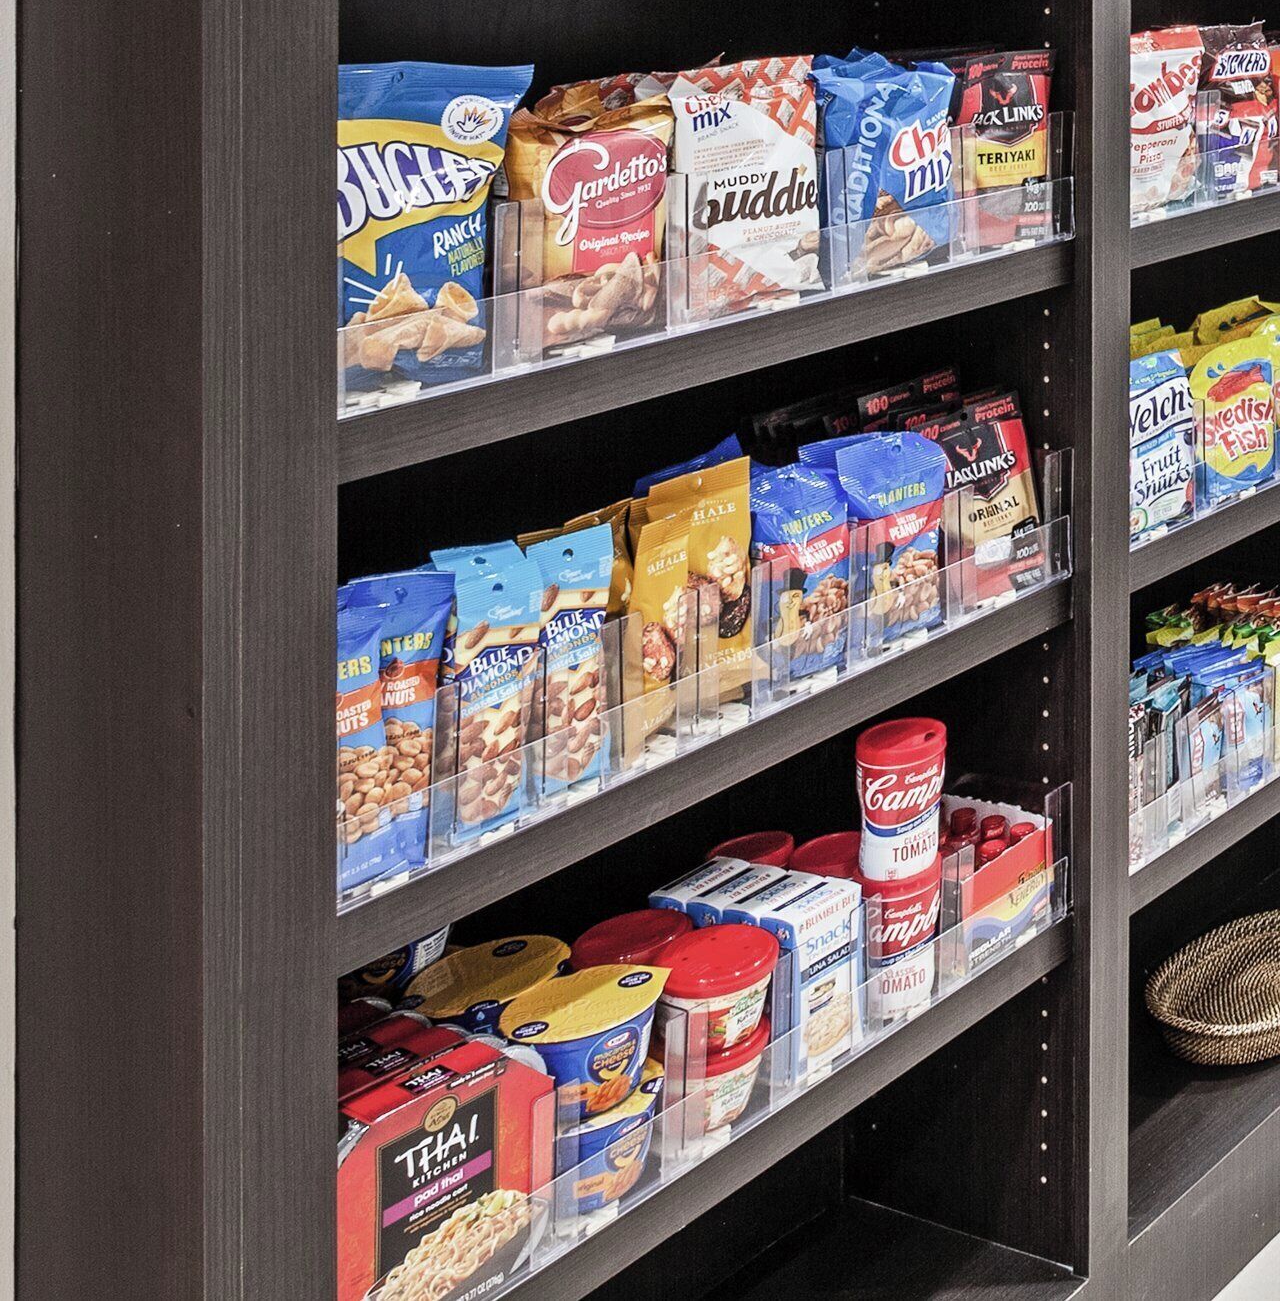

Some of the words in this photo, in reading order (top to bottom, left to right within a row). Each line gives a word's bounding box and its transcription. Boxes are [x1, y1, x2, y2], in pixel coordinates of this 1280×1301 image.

[1011, 59, 1049, 70] Protein
[1131, 56, 1201, 115] ombos
[693, 102, 732, 131] mix
[972, 112, 1003, 125] JACK
[1003, 103, 1044, 124] LINK'S
[977, 149, 1035, 165] TERIYAKI
[1139, 153, 1161, 165] Pizza
[542, 139, 667, 246] Gardetto's
[714, 173, 767, 190] MUDDY
[692, 168, 819, 230] buddie
[433, 213, 482, 259] RANCH
[579, 234, 619, 252] Original
[620, 229, 650, 243] Recipe
[866, 395, 889, 416] 100
[974, 401, 1015, 423] Protein
[1220, 424, 1269, 459] Fish
[946, 468, 973, 488] JACK
[972, 451, 1017, 480] LINK'S
[1142, 445, 1181, 481] Fruit
[545, 609, 586, 640] BLUE
[454, 646, 534, 698] DIAMOND
[469, 645, 511, 676] BLUE
[892, 831, 937, 863] TOMATO
[806, 905, 840, 930] BUMBLE
[806, 918, 850, 955] Snack
[394, 1114, 479, 1178] THAI
[412, 1151, 467, 1188] KITCHEN
[414, 1181, 440, 1208] pad
[441, 1169, 464, 1192] thai
[409, 1206, 424, 1222] rice
[425, 1193, 452, 1216] noodle
